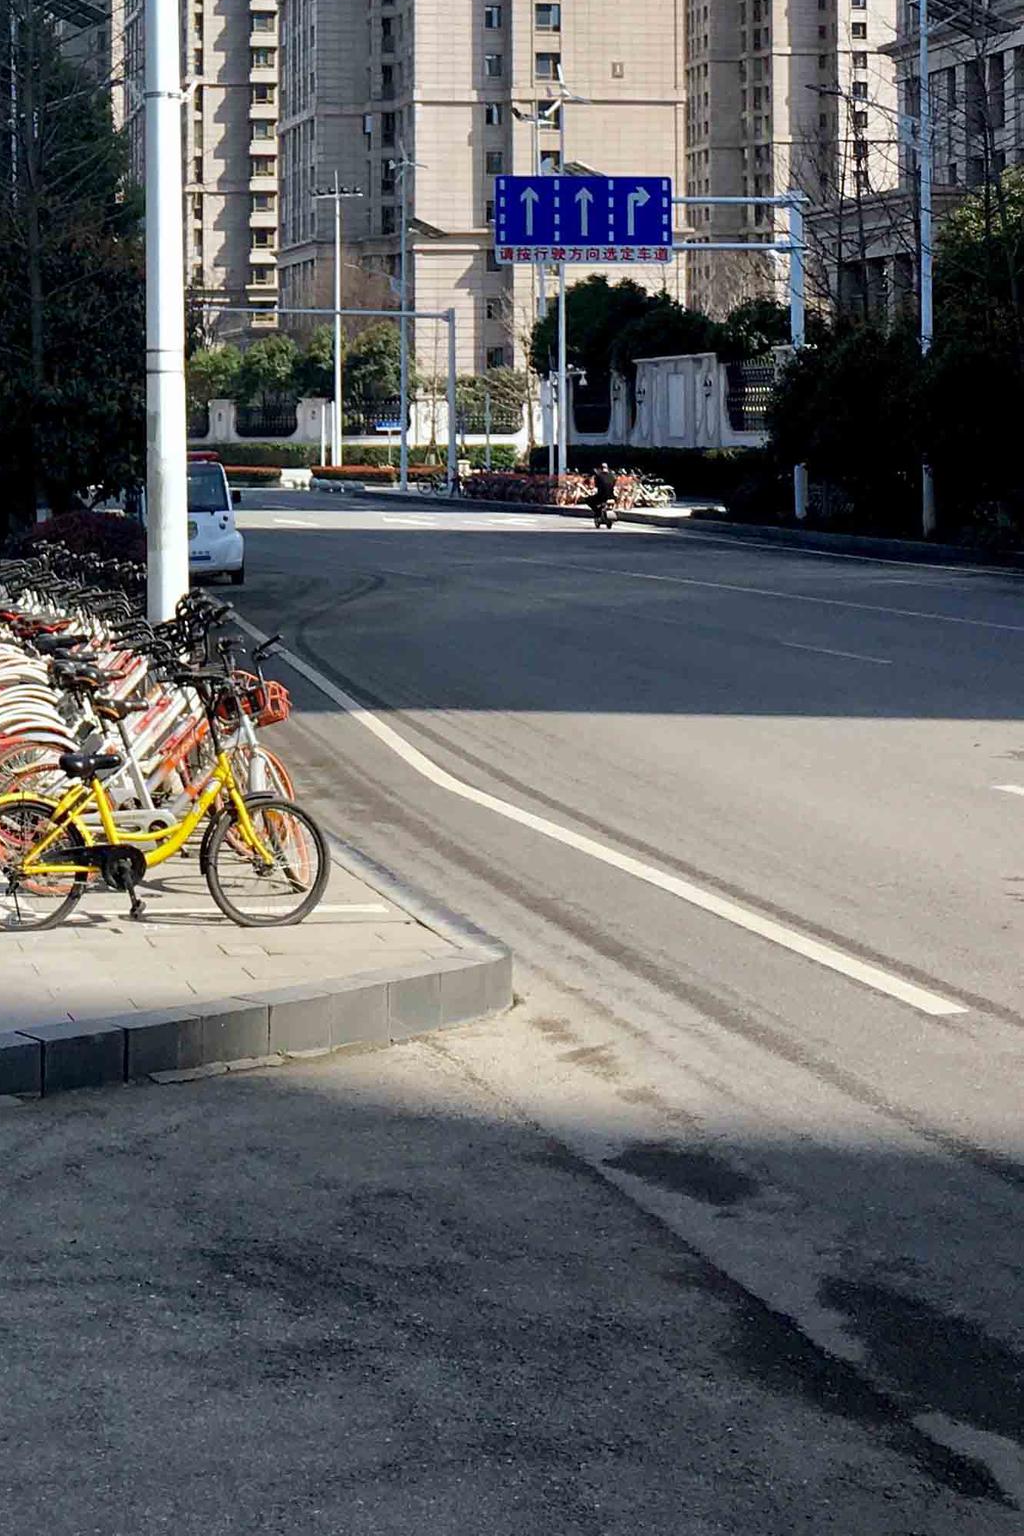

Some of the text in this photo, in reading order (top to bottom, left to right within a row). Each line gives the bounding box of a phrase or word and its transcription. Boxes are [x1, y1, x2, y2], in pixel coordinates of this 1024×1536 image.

[500, 247, 668, 261] 请按行驶方向选定车道
